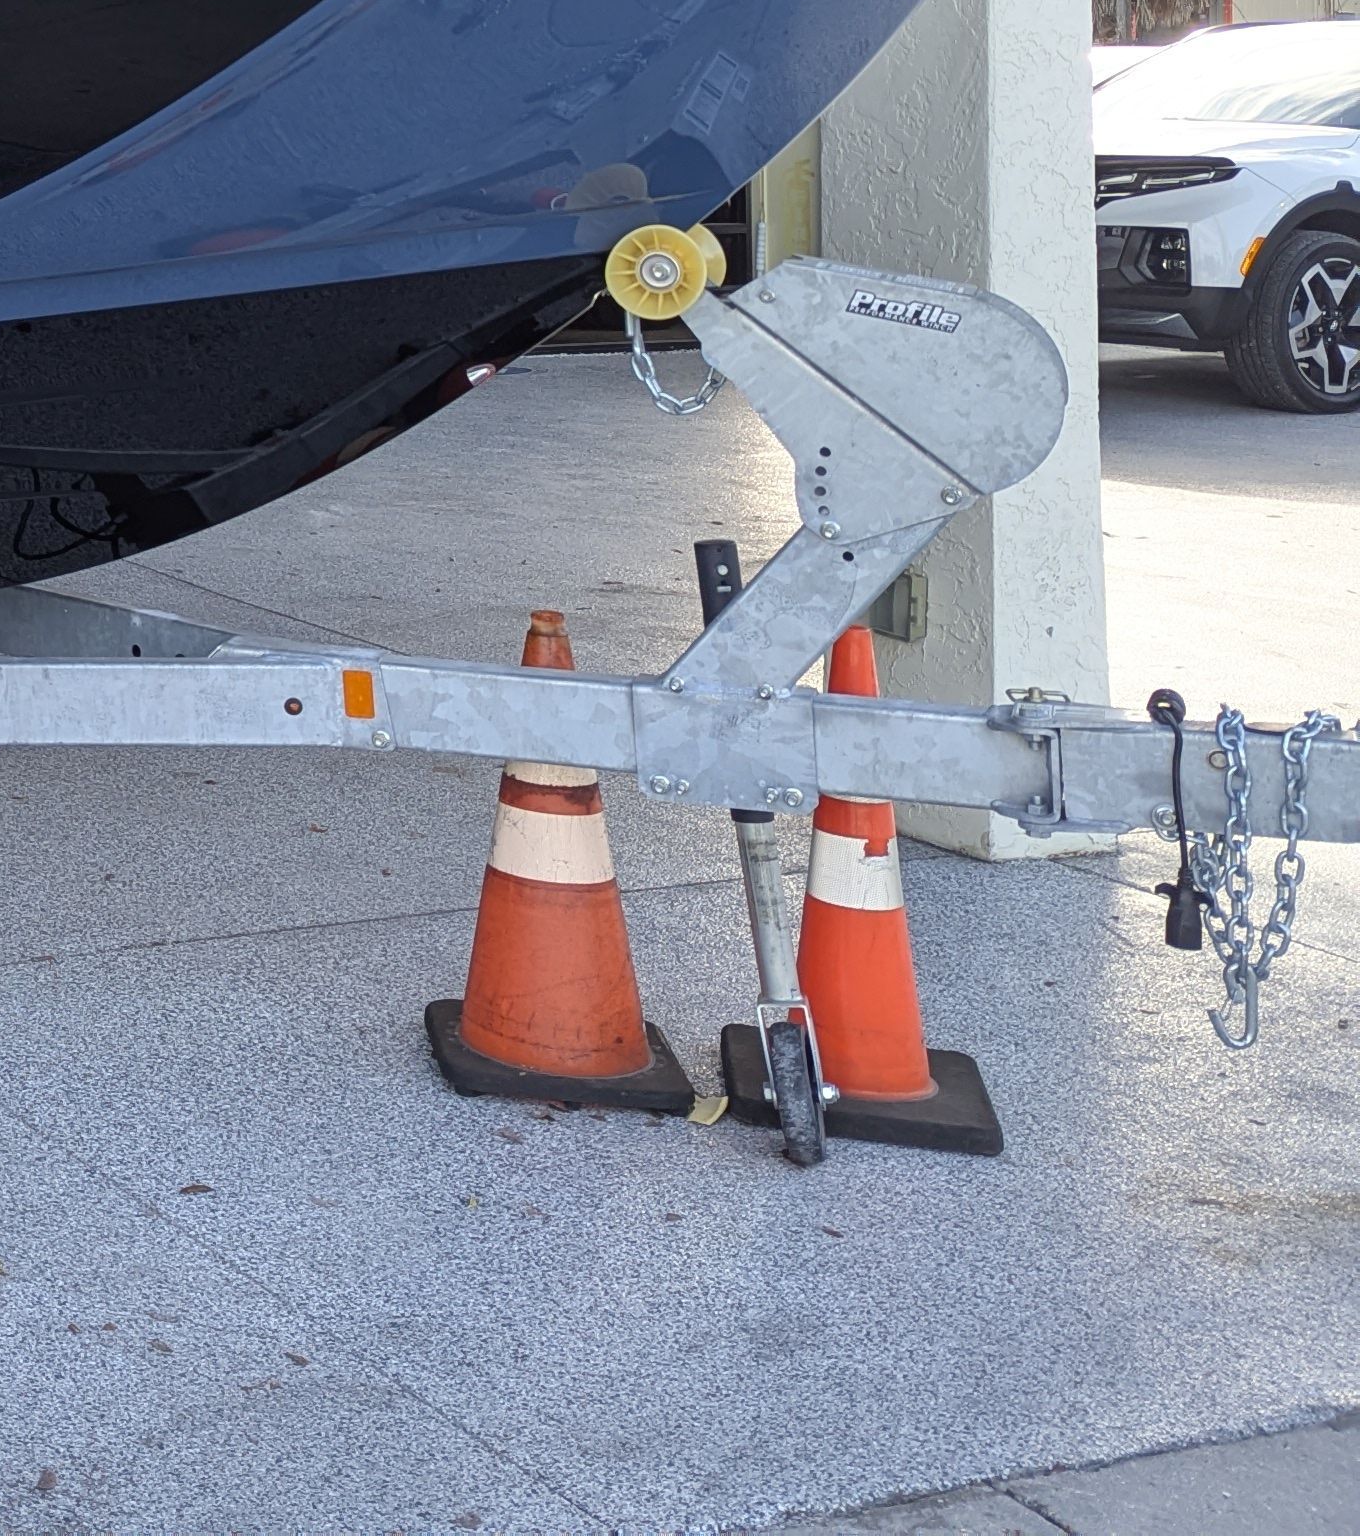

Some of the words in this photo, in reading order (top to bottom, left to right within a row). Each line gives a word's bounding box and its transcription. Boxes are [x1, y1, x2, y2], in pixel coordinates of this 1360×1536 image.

[848, 305, 918, 325] PERFORMANCE
[920, 320, 957, 332] WINCH
[850, 289, 961, 325] Profile
